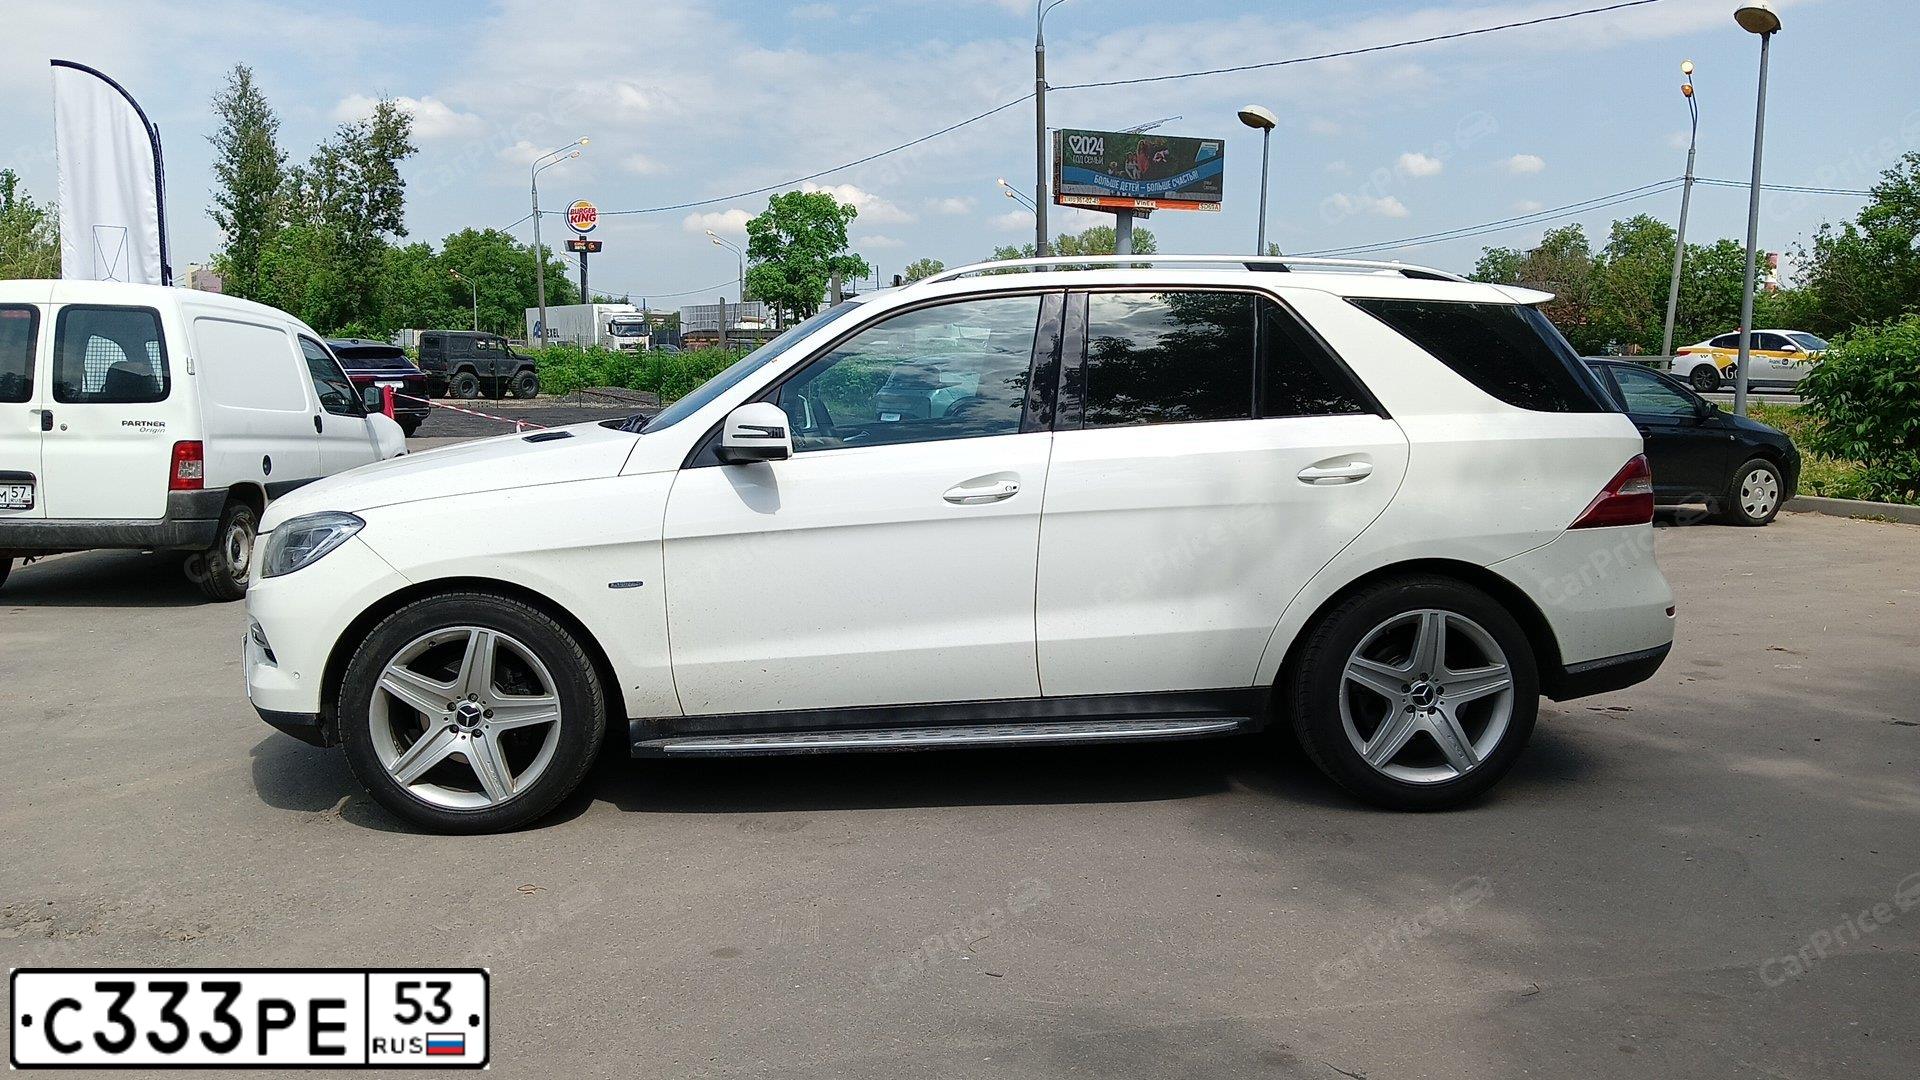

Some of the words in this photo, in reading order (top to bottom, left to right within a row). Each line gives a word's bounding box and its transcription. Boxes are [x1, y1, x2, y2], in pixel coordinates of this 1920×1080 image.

[1069, 135, 1104, 155] 2024
[1094, 175, 1120, 189] БОЛЬШЕ
[1120, 181, 1139, 191] ДЕТЕЙ
[1146, 179, 1171, 192] БОЛЬШЕ
[570, 207, 596, 215] BURGER
[570, 213, 596, 223] KING
[139, 426, 166, 434] Origin
[11, 486, 26, 498] 57
